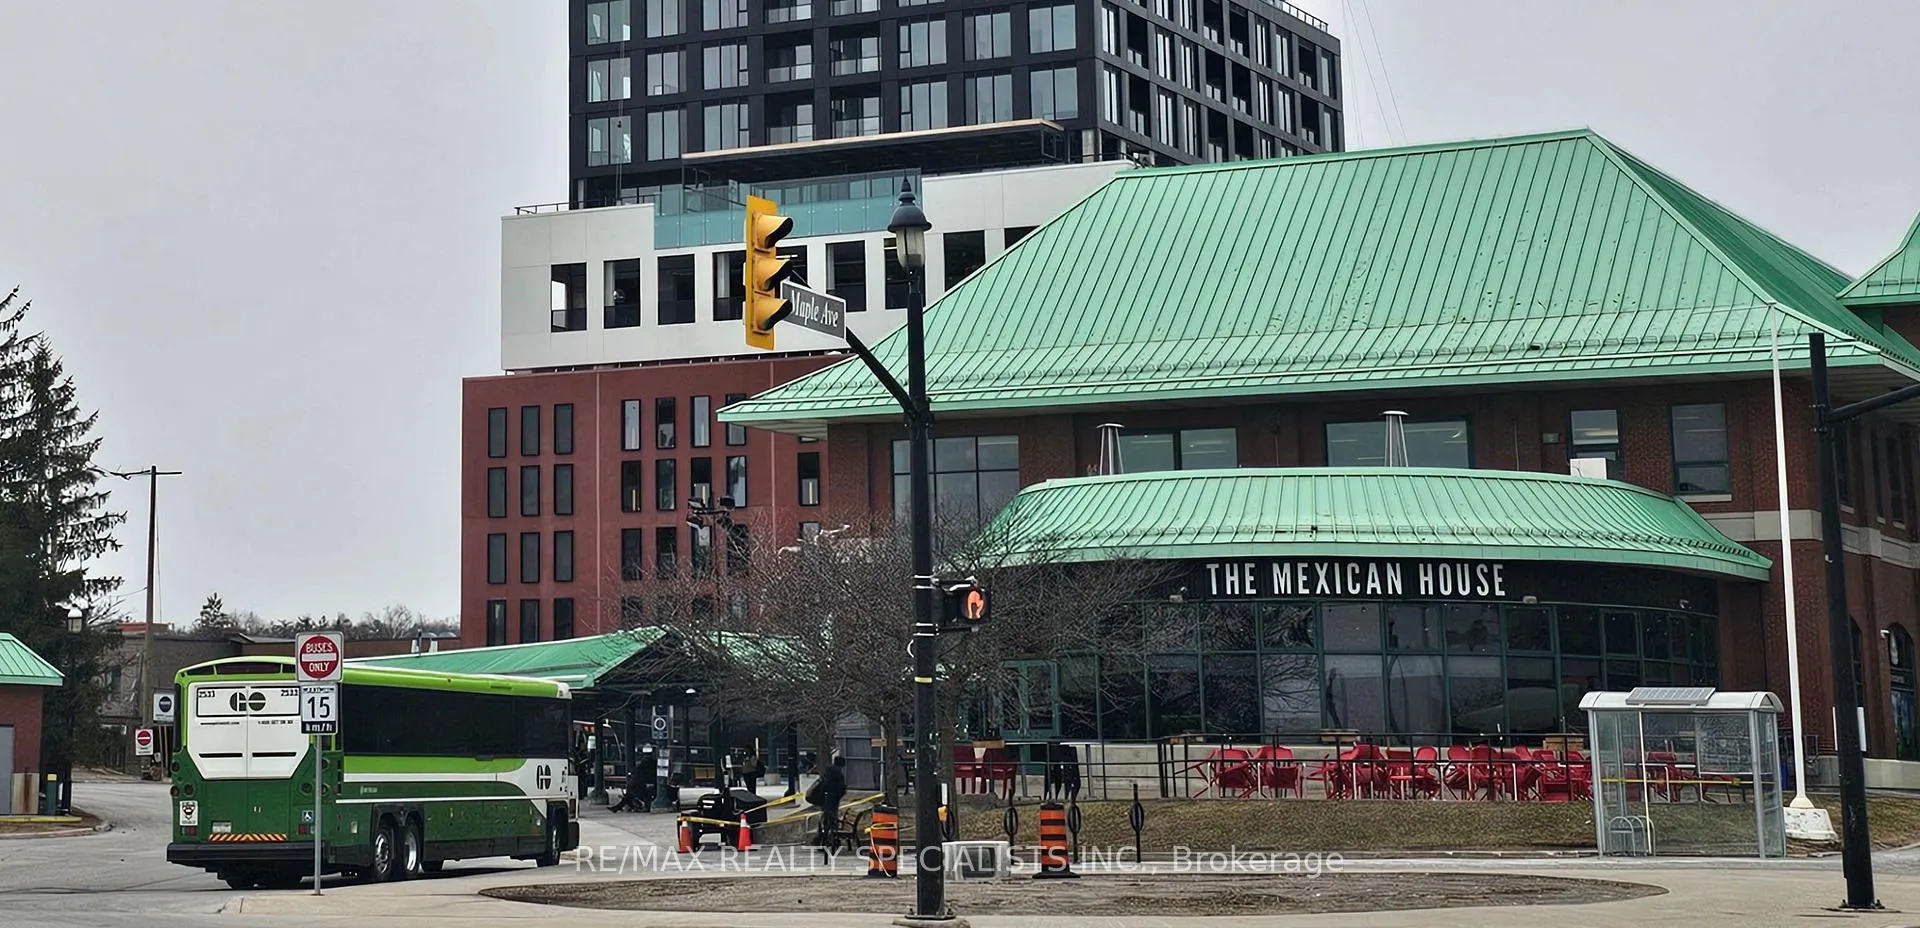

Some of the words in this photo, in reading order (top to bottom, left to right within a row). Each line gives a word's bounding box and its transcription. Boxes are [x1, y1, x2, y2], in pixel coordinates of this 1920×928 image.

[791, 289, 819, 326] Maple
[820, 301, 839, 327] Ave
[1206, 563, 1256, 595] THE
[1272, 562, 1402, 595] MEXICAN
[1418, 563, 1506, 596] HOUSE
[306, 643, 333, 653] BUSES
[309, 662, 329, 672] ONLY
[307, 696, 330, 719] 15
